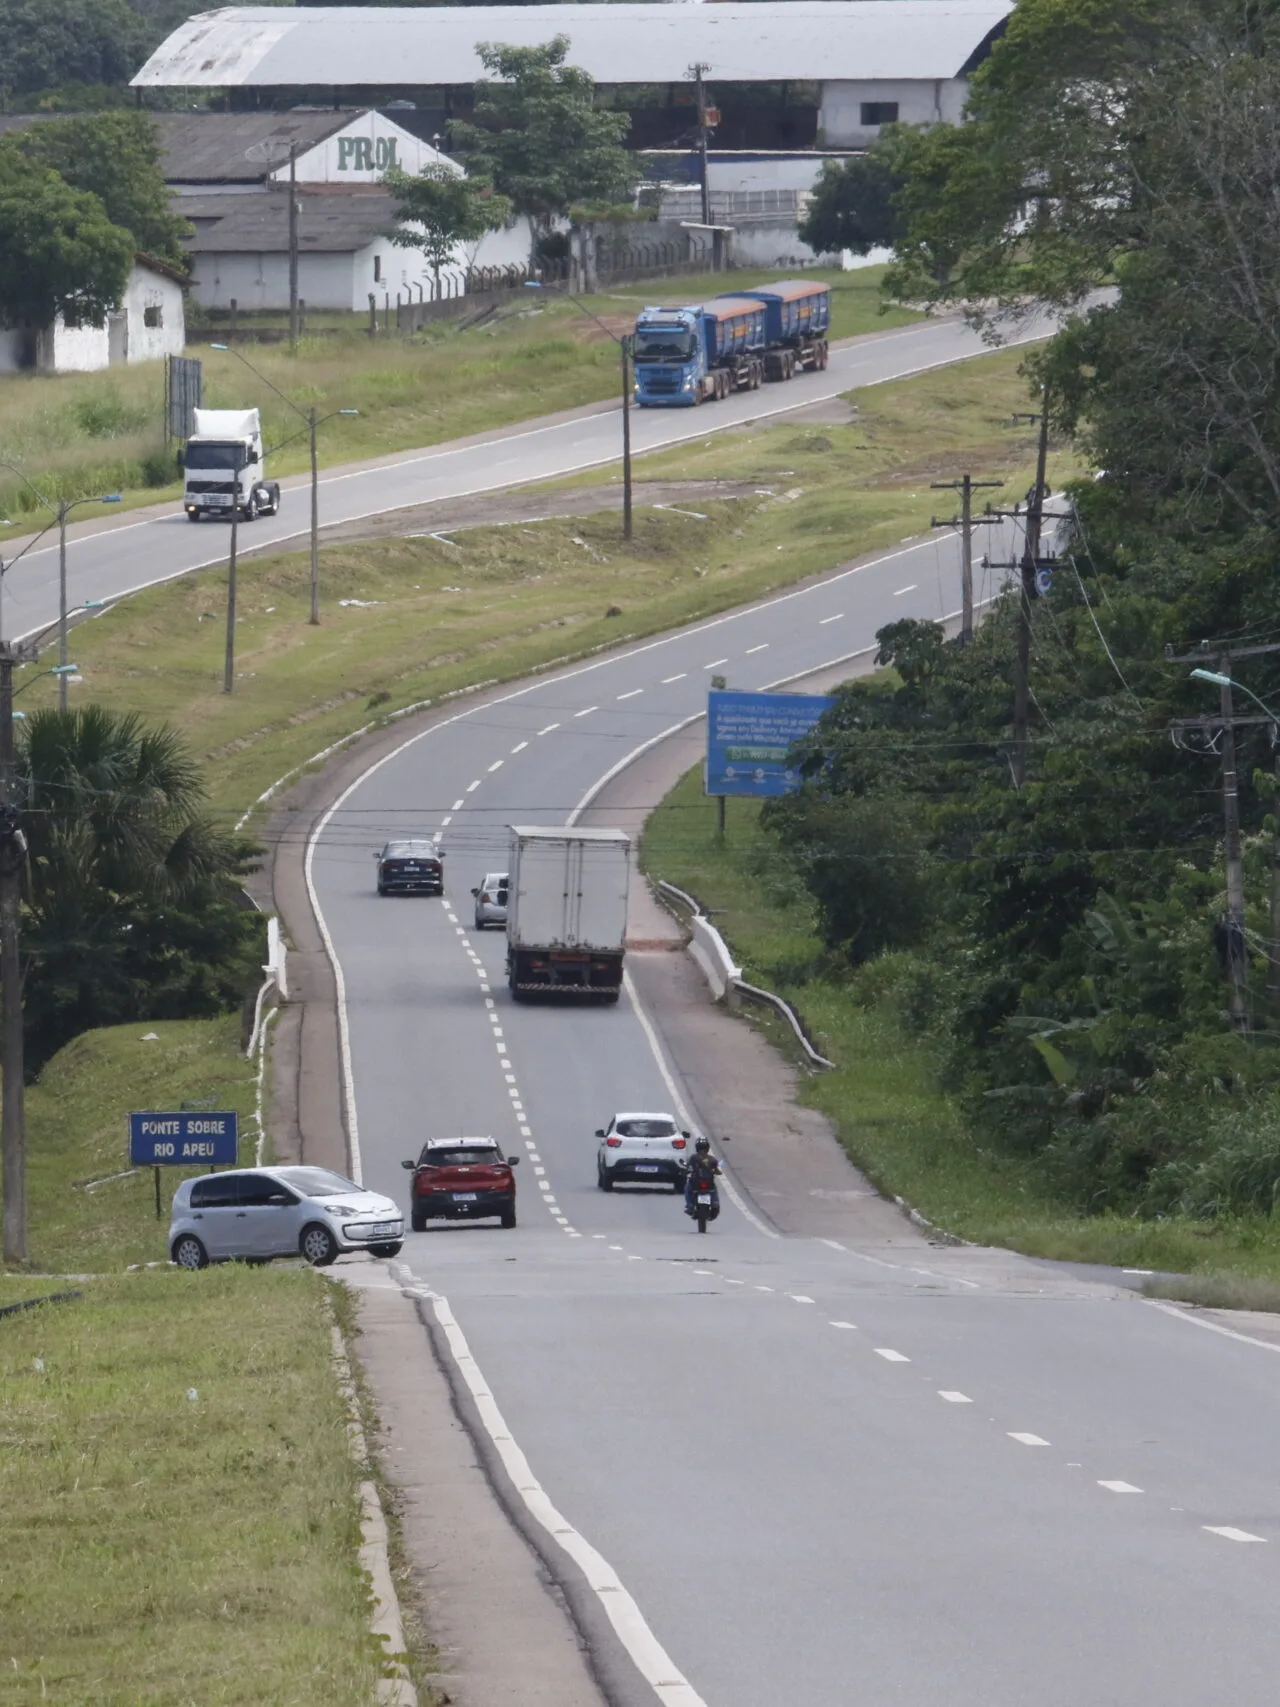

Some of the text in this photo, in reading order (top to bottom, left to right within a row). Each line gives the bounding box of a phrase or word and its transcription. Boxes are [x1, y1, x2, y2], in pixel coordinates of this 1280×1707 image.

[337, 137, 402, 171] PROL
[142, 1121, 225, 1135] PONTE SOBRE
[154, 1143, 175, 1156] RIO
